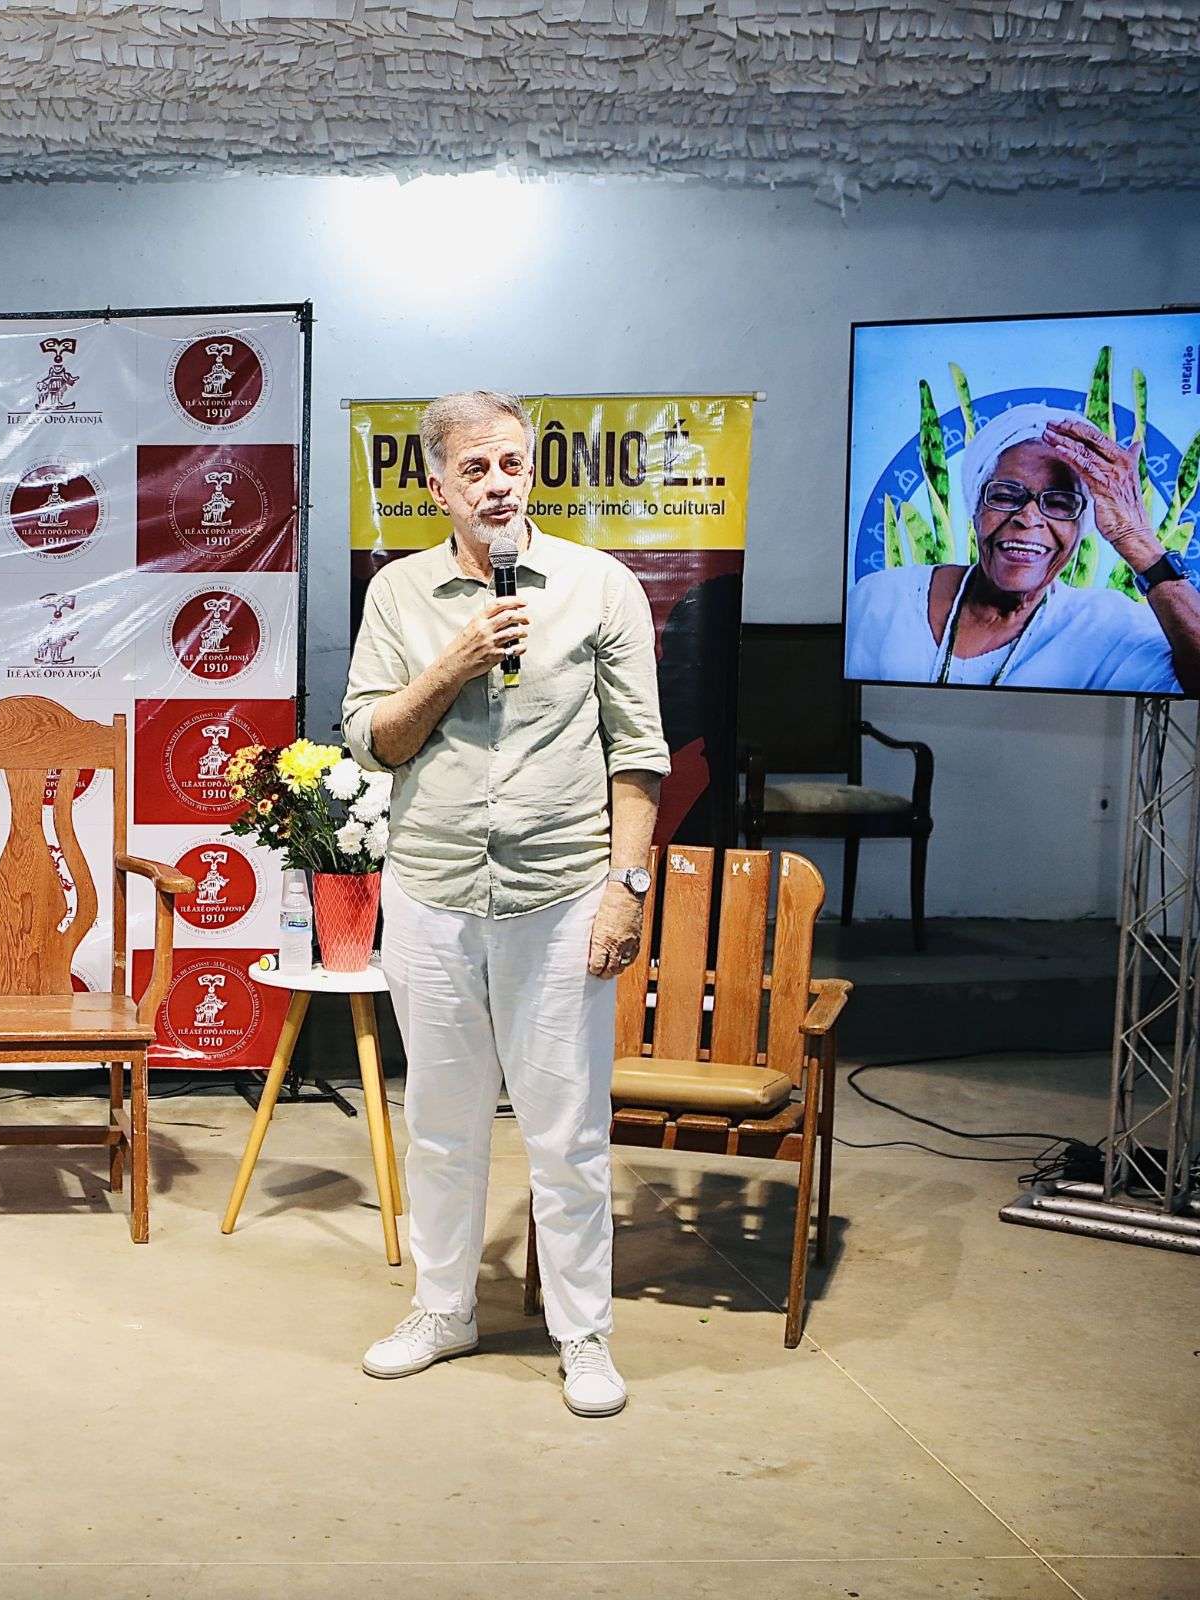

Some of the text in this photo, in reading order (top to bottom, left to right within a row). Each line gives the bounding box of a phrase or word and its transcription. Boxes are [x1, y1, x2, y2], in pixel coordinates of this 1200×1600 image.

[207, 408, 231, 418] 1910
[7, 415, 103, 426] ILÊ OPÔ AFONJÁ
[372, 420, 647, 489] PAÔNIO
[375, 501, 412, 516] Roda
[417, 501, 438, 516] de
[526, 500, 563, 516] obre
[664, 500, 725, 516] cultural
[206, 536, 230, 546] 1910
[204, 663, 228, 672] 1910
[6, 669, 22, 678] ILÊ
[24, 669, 42, 678] AXÉ
[44, 669, 65, 678] OPÔ
[202, 789, 226, 799] 1910
[201, 914, 225, 923] 1910
[198, 1037, 223, 1046] 1910
